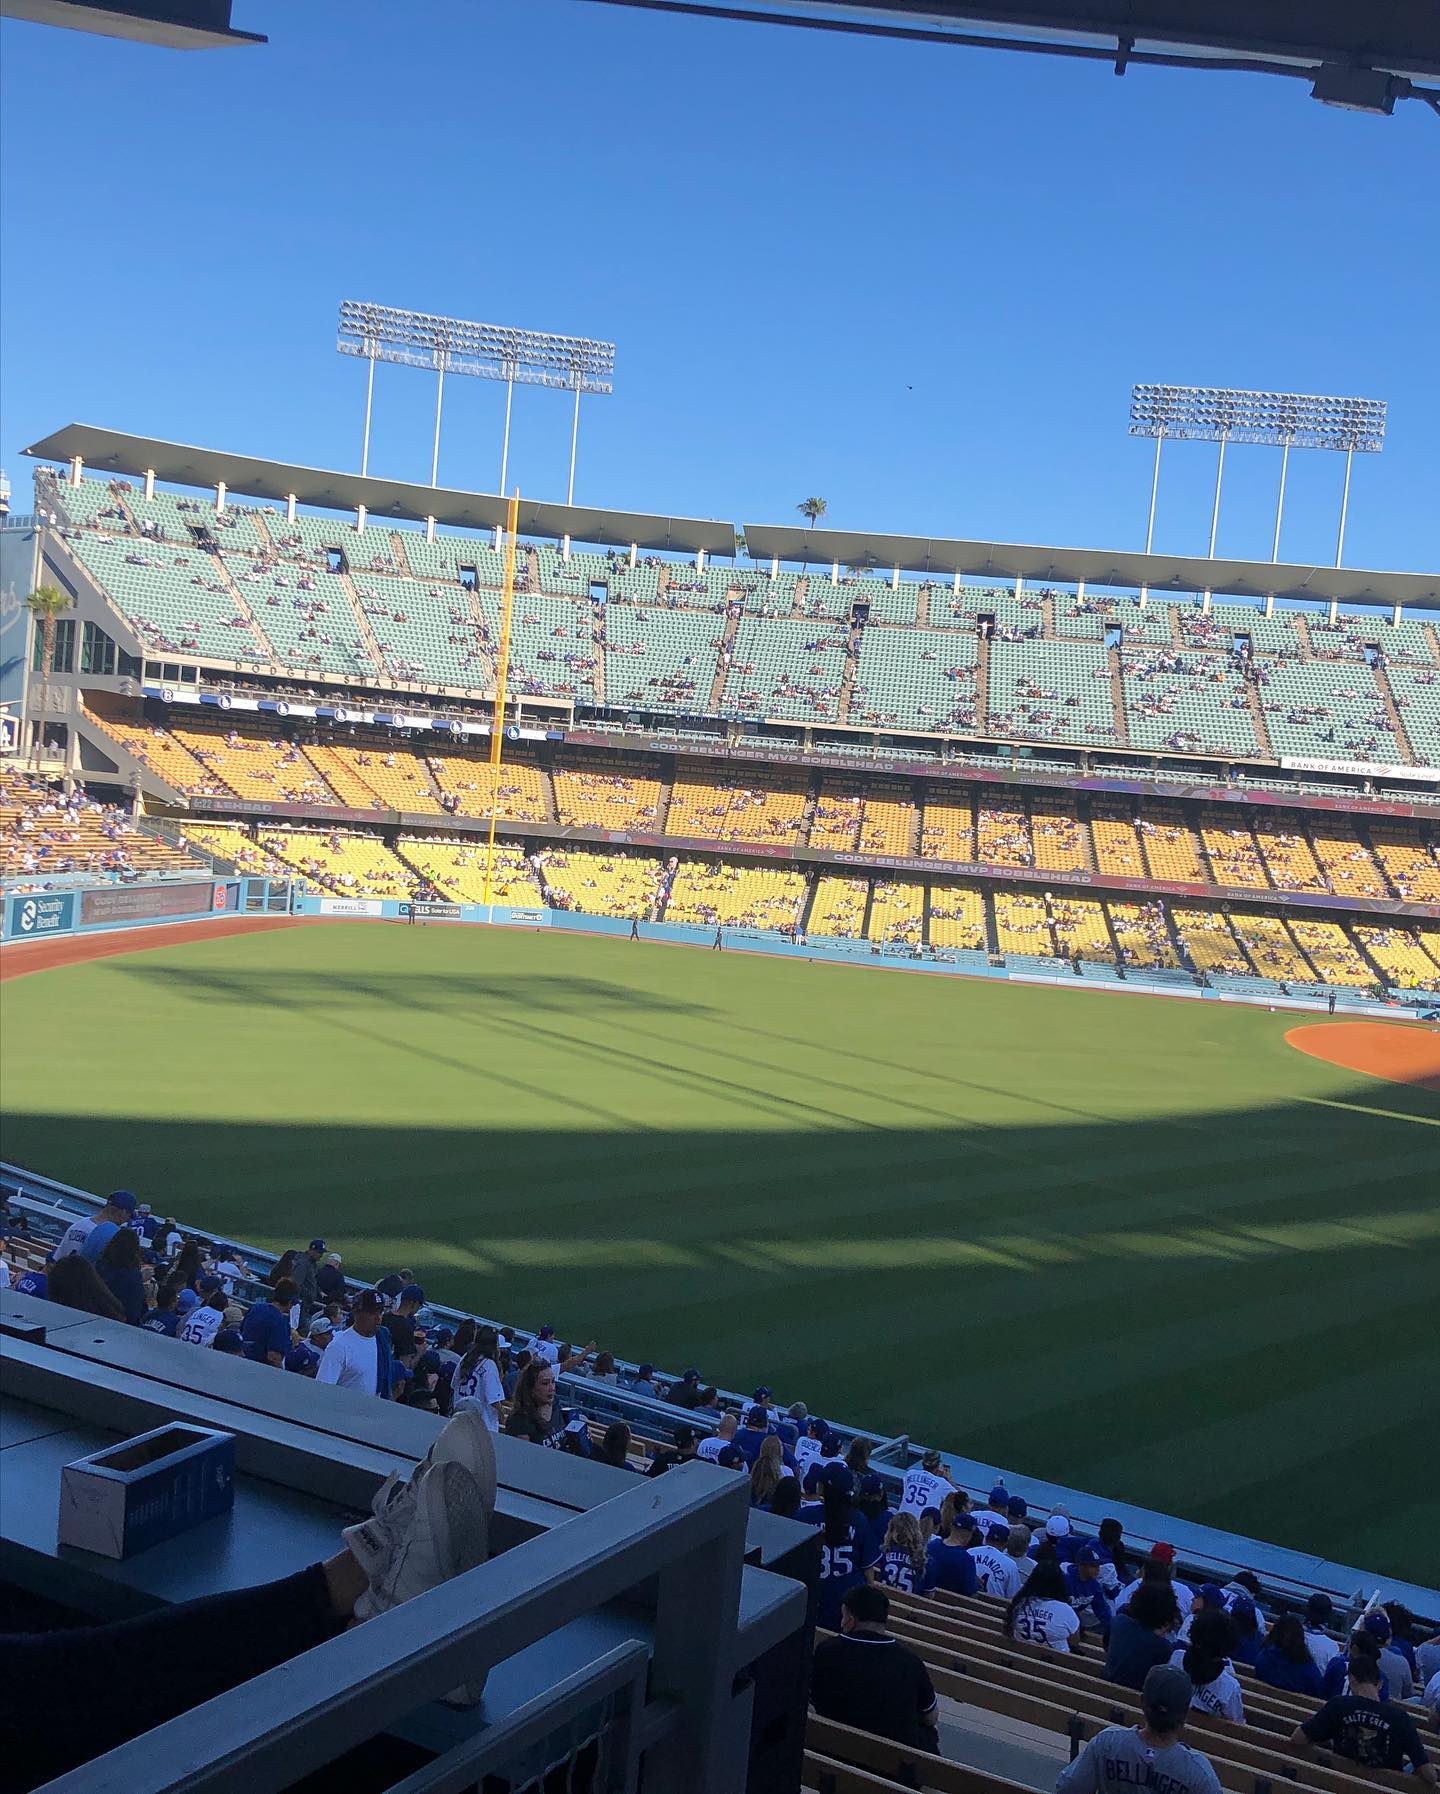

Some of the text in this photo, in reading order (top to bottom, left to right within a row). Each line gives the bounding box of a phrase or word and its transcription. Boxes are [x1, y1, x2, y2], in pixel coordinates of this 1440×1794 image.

[235, 662, 326, 682] DODGER
[344, 675, 447, 695] STADIUM
[650, 742, 894, 770] CODY BELLINGER MVP BOBBLEHEAD
[1291, 762, 1316, 770] BANK
[1332, 765, 1372, 774] AMERICA
[193, 798, 212, 809] 6:22
[834, 854, 1092, 883] CODY BELLINGER MVP BOBBLEHEAD
[1125, 882, 1141, 890] BANK
[38, 898, 64, 914] Security
[1252, 894, 1278, 902] AMERICA
[450, 908, 460, 916] USA
[37, 913, 60, 929] Benefit
[181, 1324, 204, 1345] 35
[906, 1473, 939, 1490] BELLINGER
[905, 1485, 930, 1506] 35
[820, 1544, 853, 1579] 35
[1017, 1618, 1048, 1644] 35
[1343, 1713, 1367, 1726] SALTY
[1369, 1716, 1391, 1731] CREW
